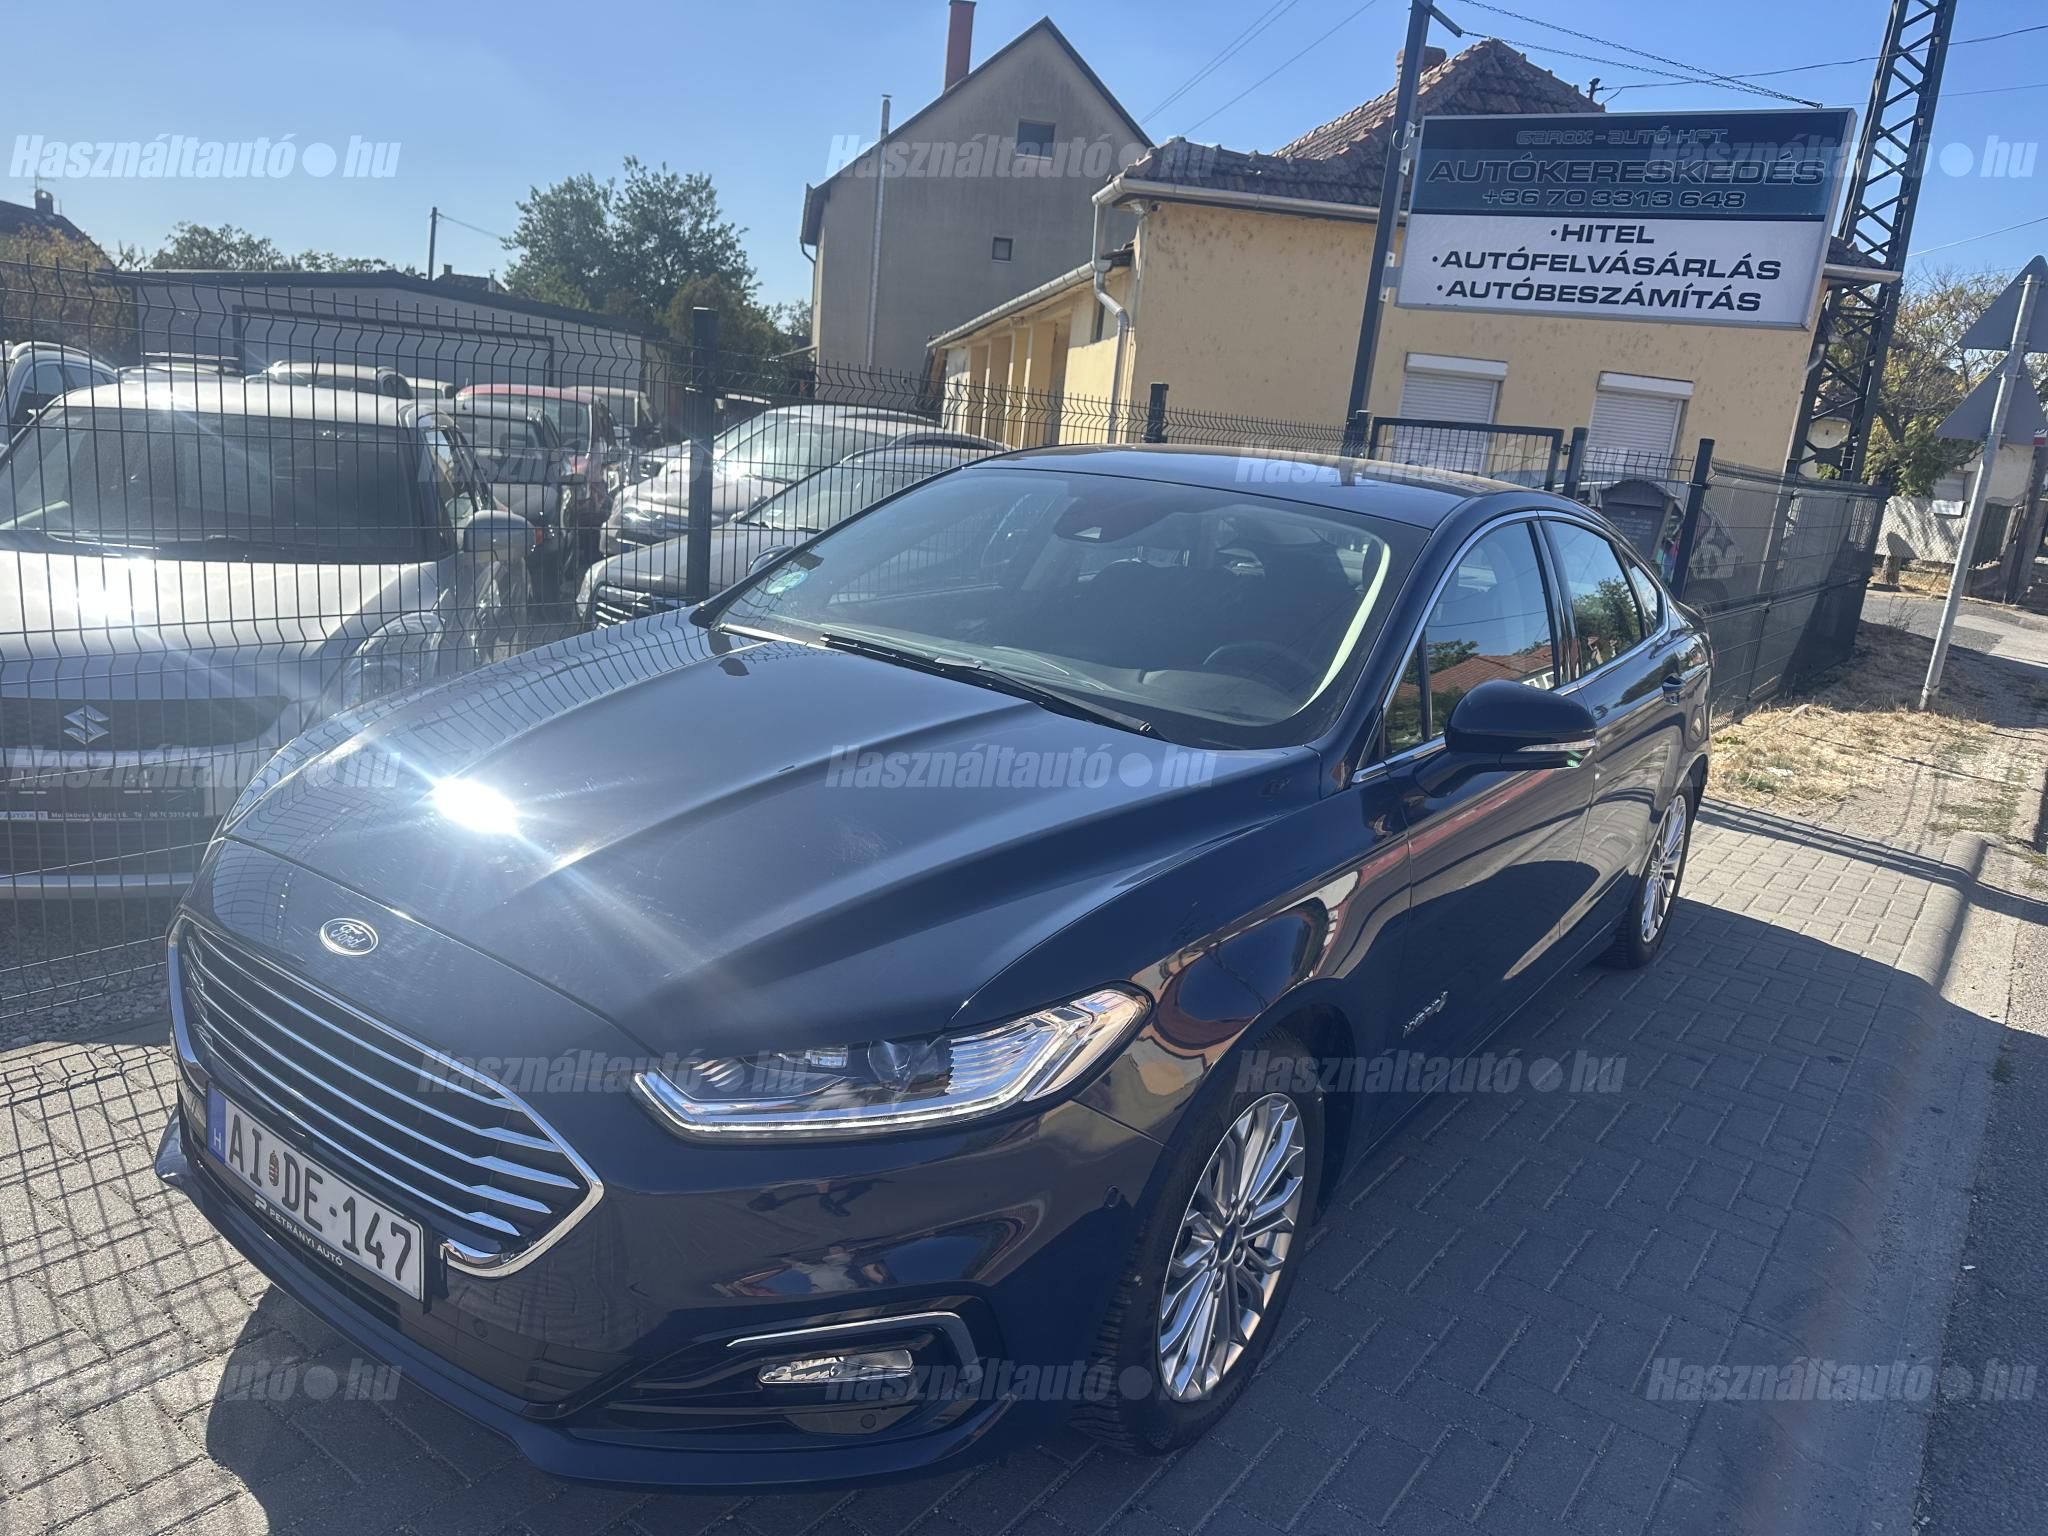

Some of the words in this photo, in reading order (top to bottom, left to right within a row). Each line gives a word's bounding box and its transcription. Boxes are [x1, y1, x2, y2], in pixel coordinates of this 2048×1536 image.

[1426, 151, 1825, 185] AUTÓKERESKEDÉS
[1482, 188, 1540, 206] +36
[1546, 188, 1588, 206] 70
[1591, 189, 1673, 207] 3313
[1679, 190, 1746, 208] 648
[1560, 223, 1655, 244] HITEL
[1440, 246, 1782, 280] AUTÓFELVÁSÁRLÁS
[1445, 276, 1762, 312] AUTÓBESZÁMÍTÁS
[317, 1245, 343, 1266] AUTÓ
